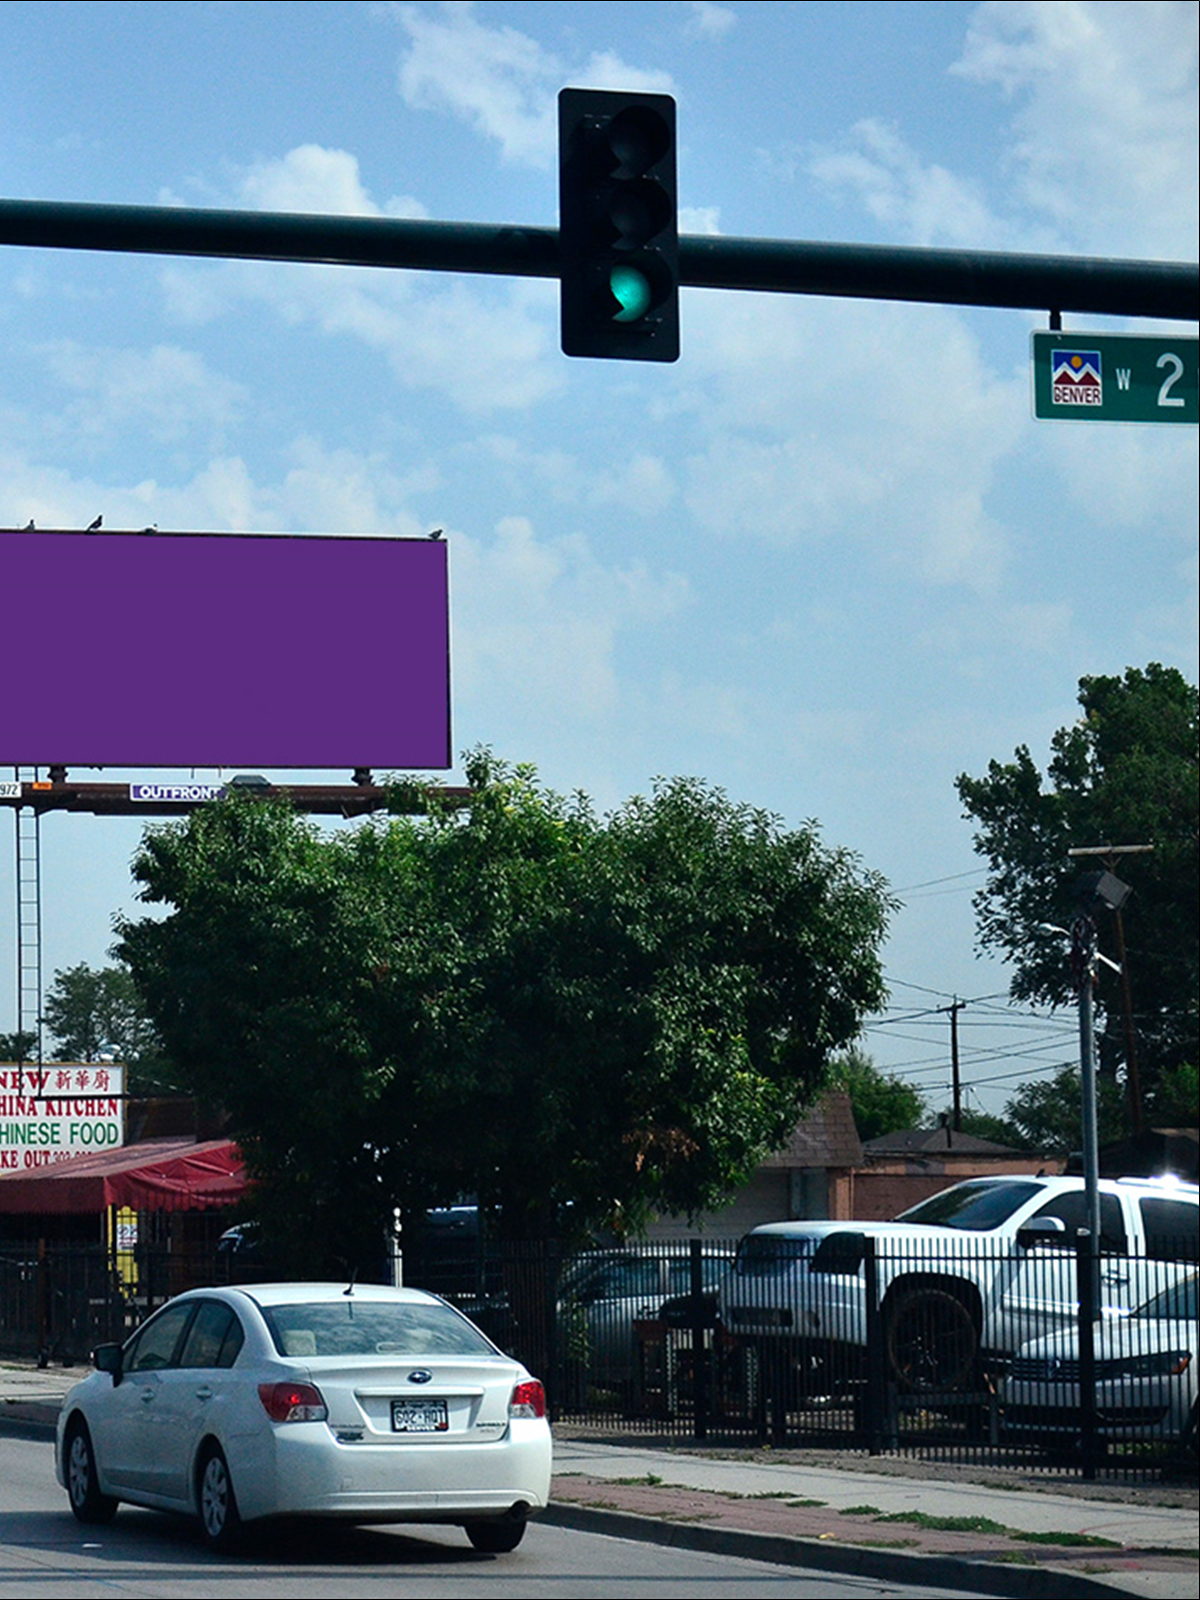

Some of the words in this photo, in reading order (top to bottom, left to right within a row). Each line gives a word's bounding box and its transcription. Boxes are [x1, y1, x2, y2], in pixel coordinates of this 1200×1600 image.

[1116, 368, 1131, 390] W
[1053, 386, 1101, 404] DENVER
[140, 785, 222, 800] OUTFRONT
[45, 1096, 118, 1117] KITCHEN
[70, 1122, 119, 1145] FOOD
[24, 1150, 51, 1168] OUT
